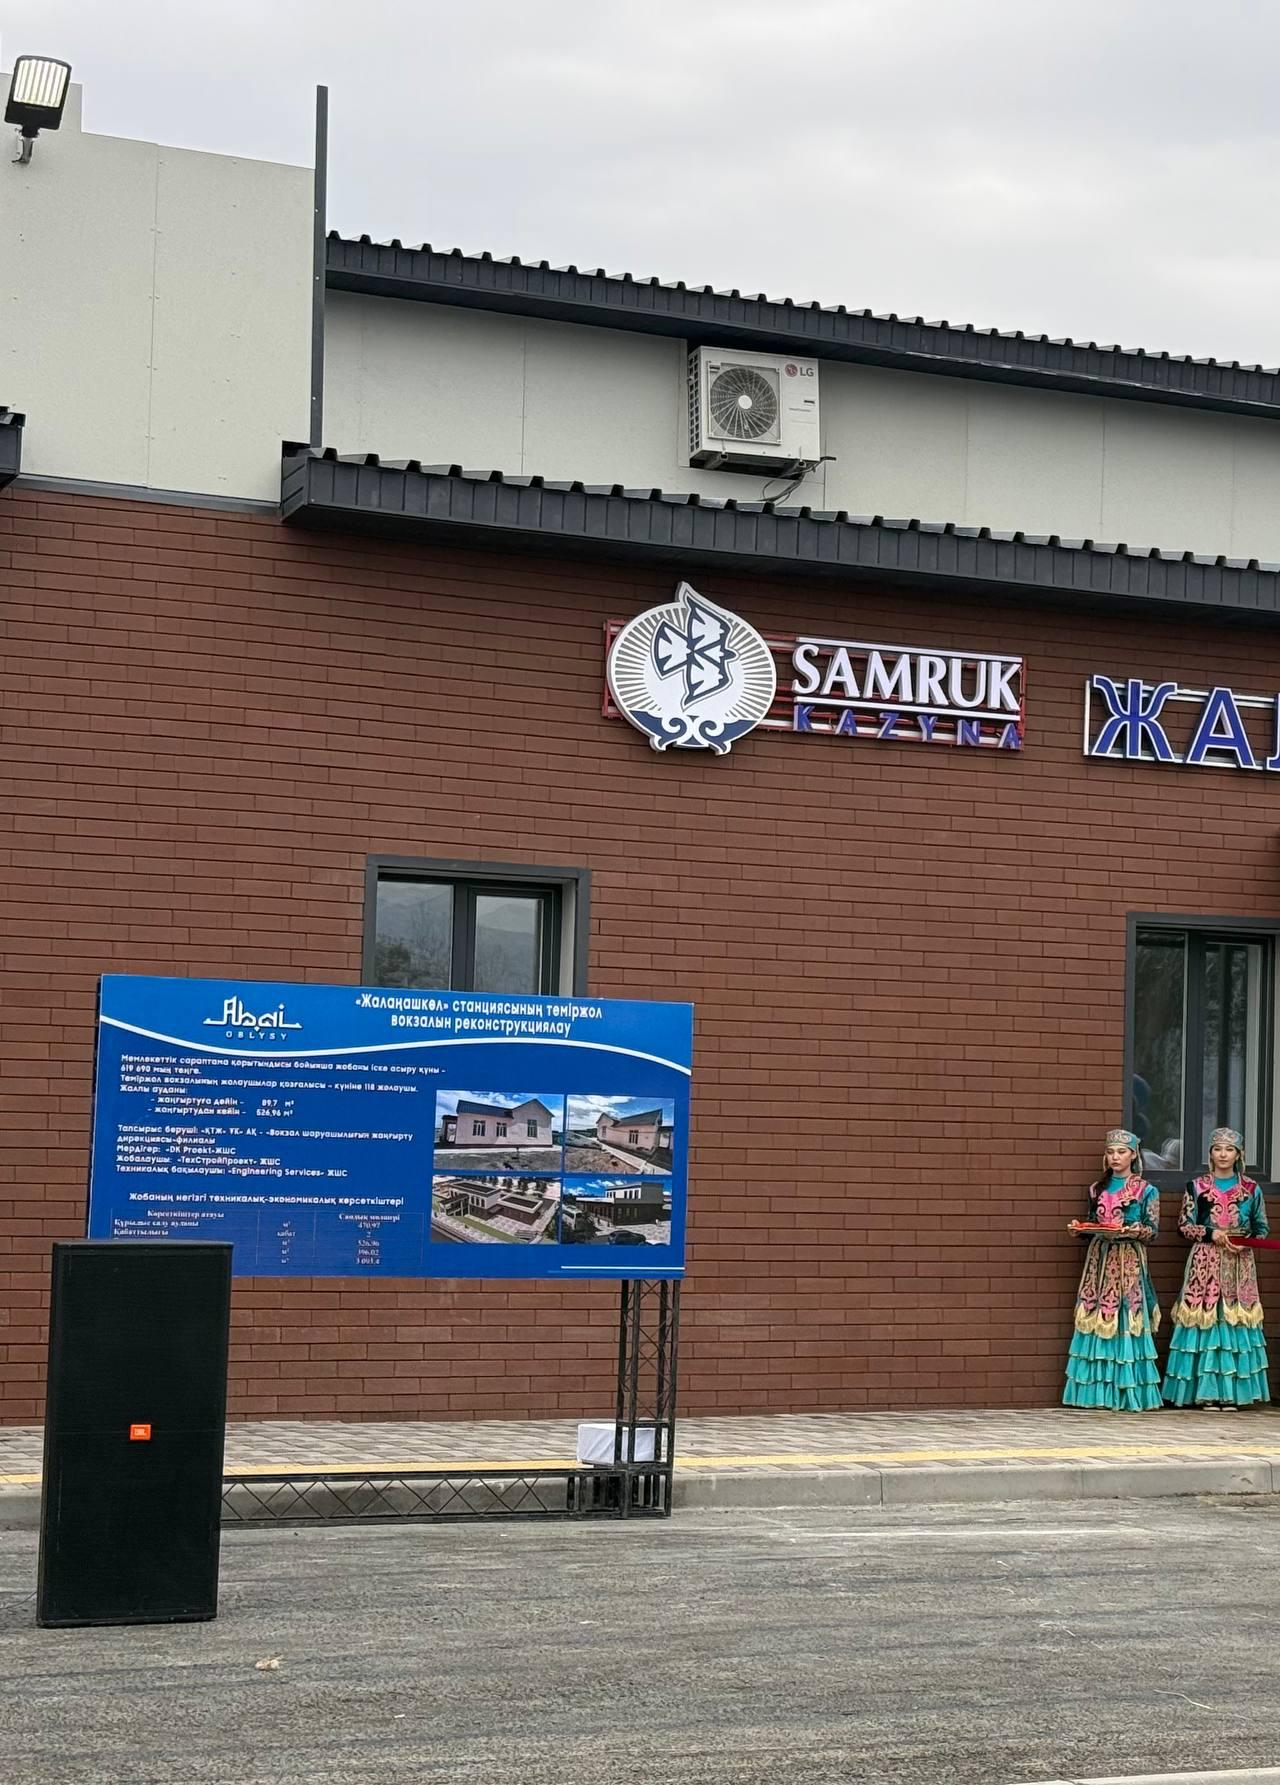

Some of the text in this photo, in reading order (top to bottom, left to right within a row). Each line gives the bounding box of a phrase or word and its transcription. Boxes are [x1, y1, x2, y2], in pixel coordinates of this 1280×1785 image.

[800, 367, 814, 377] LG
[792, 644, 1022, 712] SAMRUK
[793, 704, 1021, 750] KAZYNA
[453, 999, 543, 1017] станциясының
[547, 1003, 602, 1021] теміржол
[391, 1015, 571, 1038] вокзалын реконструкциялау
[226, 1031, 287, 1040] OBLYSY
[120, 1064, 133, 1072] 619
[121, 1054, 177, 1064] Мемлекеттік
[294, 1061, 333, 1070] бойынша
[336, 1063, 369, 1071] жобаны
[371, 1064, 388, 1072] іске
[390, 1066, 416, 1075] асыру
[120, 1075, 161, 1084] Теміржол
[221, 1079, 277, 1088] жолаушылар
[120, 1084, 150, 1093] Жалпы
[213, 1097, 238, 1106] дейін
[217, 1107, 240, 1115] кейін
[118, 1124, 162, 1134] Тапсырыс
[260, 1157, 281, 1166] ЖШС
[328, 1169, 348, 1177] ЖШС
[129, 1192, 174, 1202] Жобаның
[176, 1193, 207, 1202] негізгі
[338, 1196, 404, 1206] көрсеткіштері
